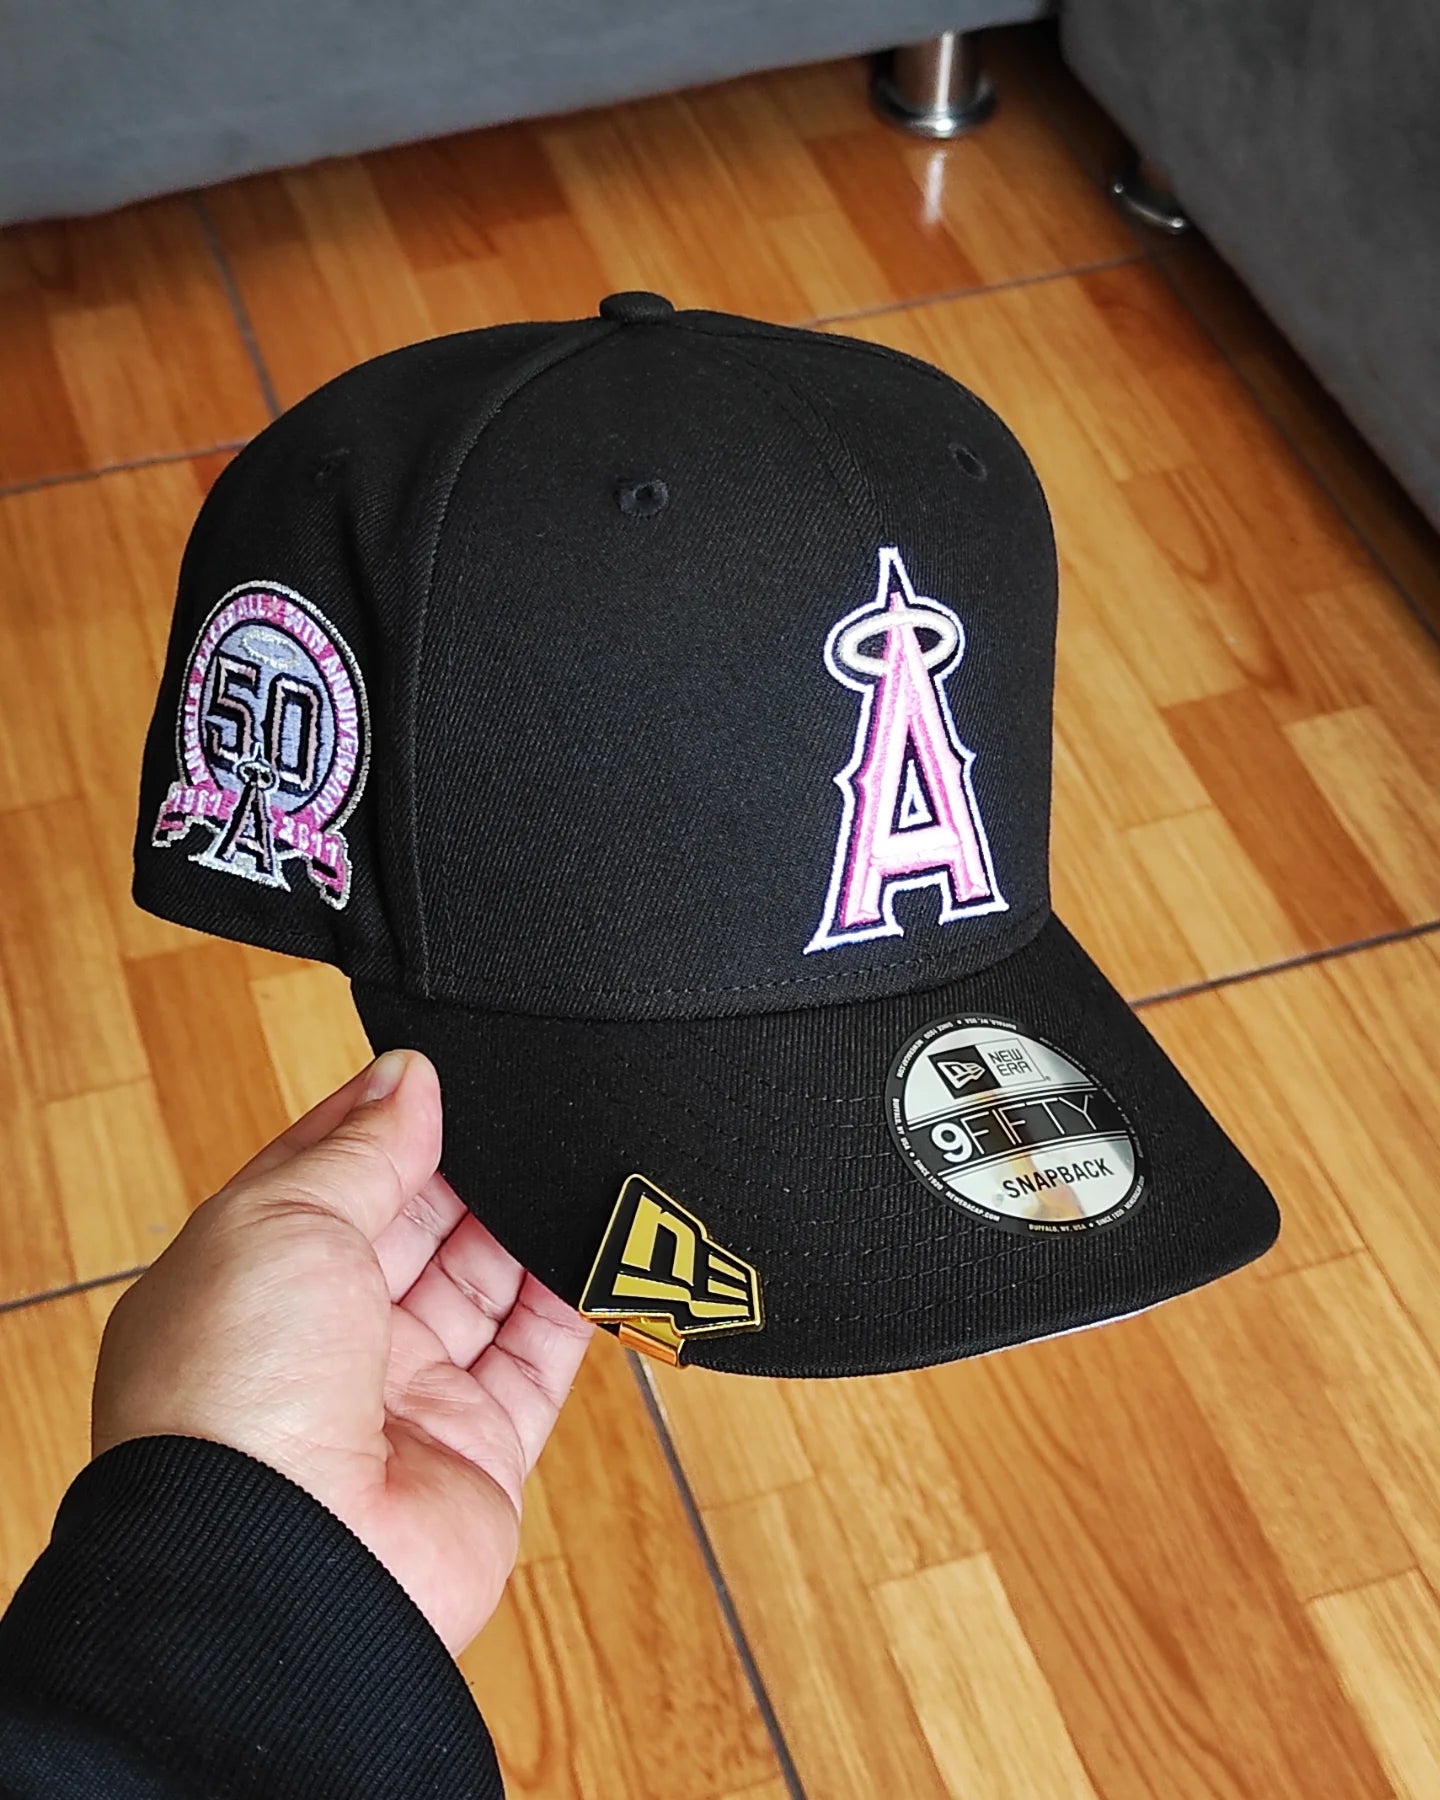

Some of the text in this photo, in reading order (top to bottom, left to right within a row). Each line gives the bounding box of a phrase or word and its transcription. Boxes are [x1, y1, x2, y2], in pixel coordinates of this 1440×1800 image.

[205, 652, 324, 798] 50
[310, 655, 359, 826] ANNIVERSARY
[803, 545, 1010, 954] A
[987, 1047, 1024, 1065] NEW
[998, 1061, 1033, 1077] ERA
[931, 1094, 1097, 1163] 9FIFTY
[1003, 1158, 1115, 1199] SNAPBACK
[945, 1191, 1001, 1222] NEWERACAP.COM
